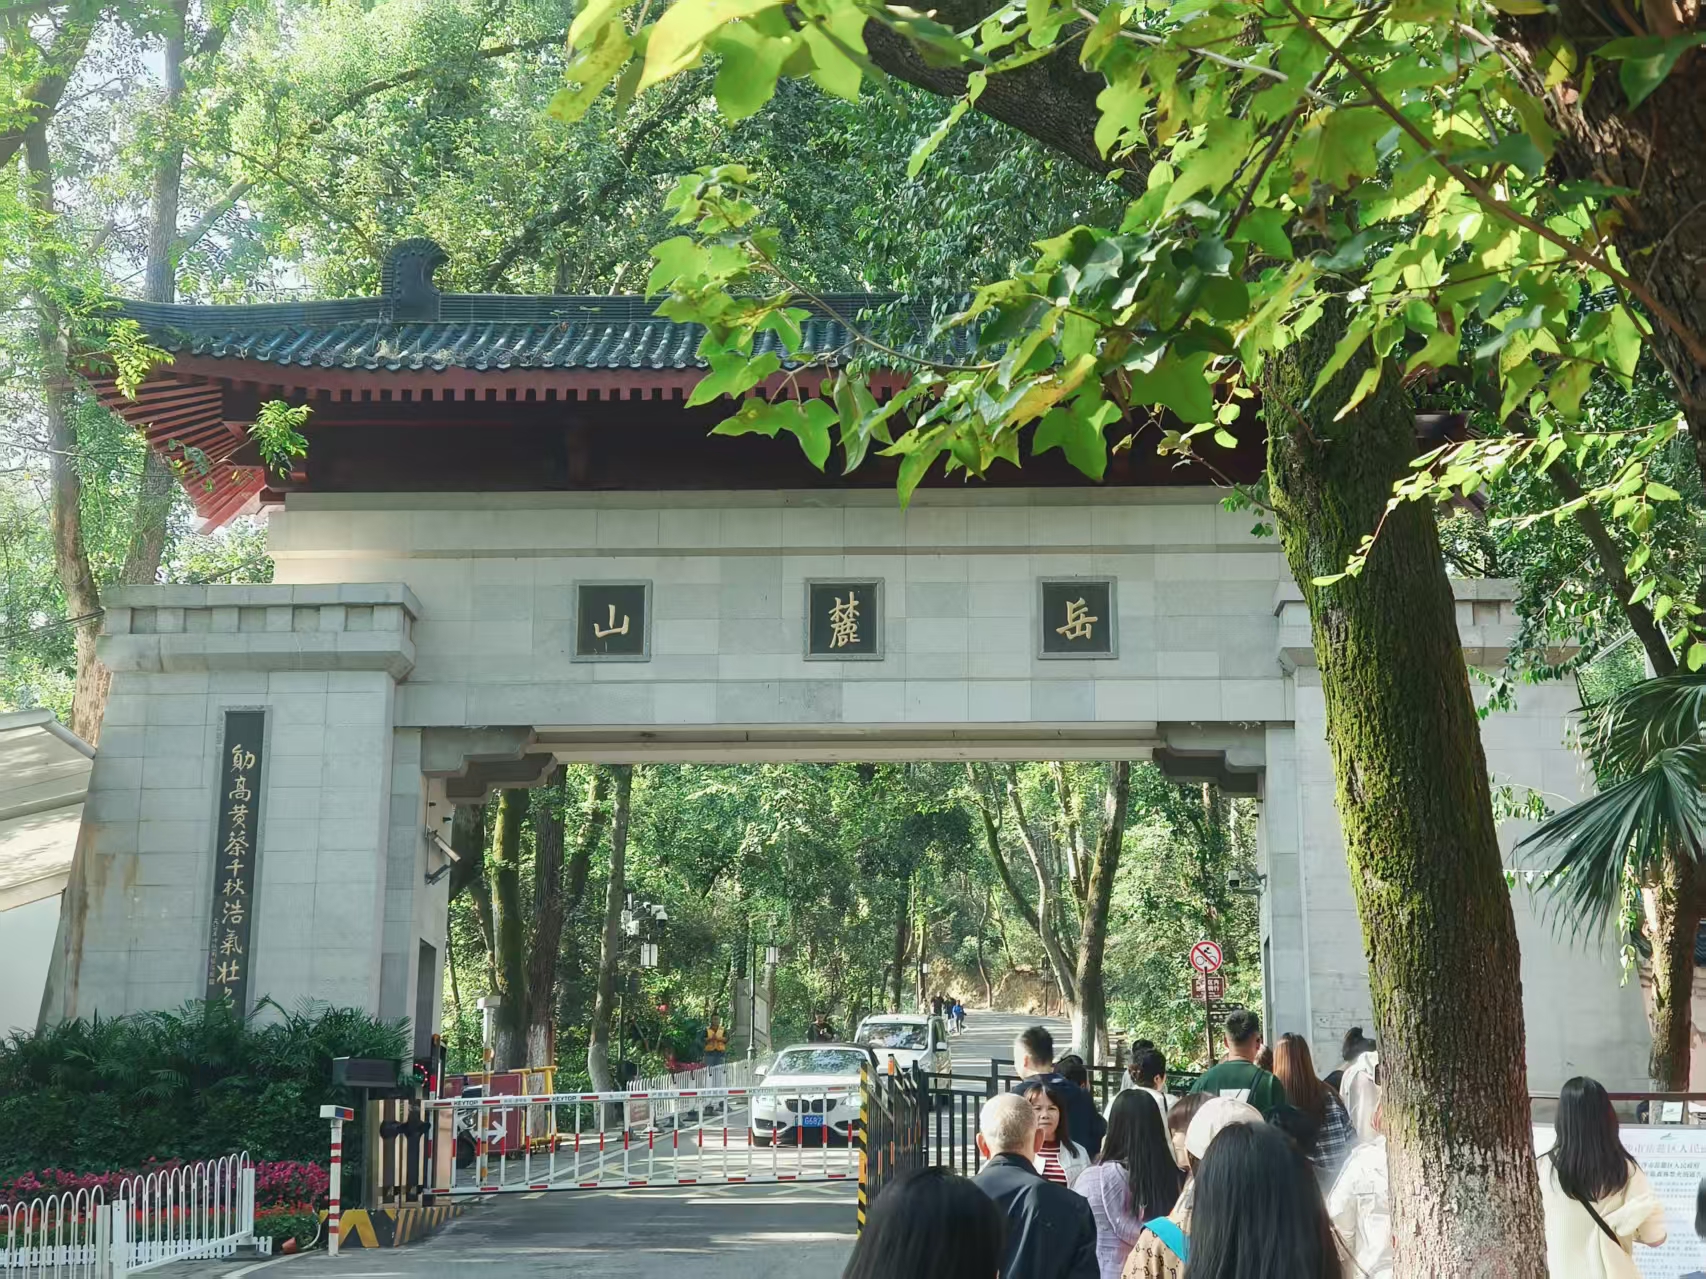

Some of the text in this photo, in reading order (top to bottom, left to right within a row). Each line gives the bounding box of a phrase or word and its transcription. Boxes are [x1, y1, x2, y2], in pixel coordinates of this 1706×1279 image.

[593, 591, 1098, 648] 岳 麓 山
